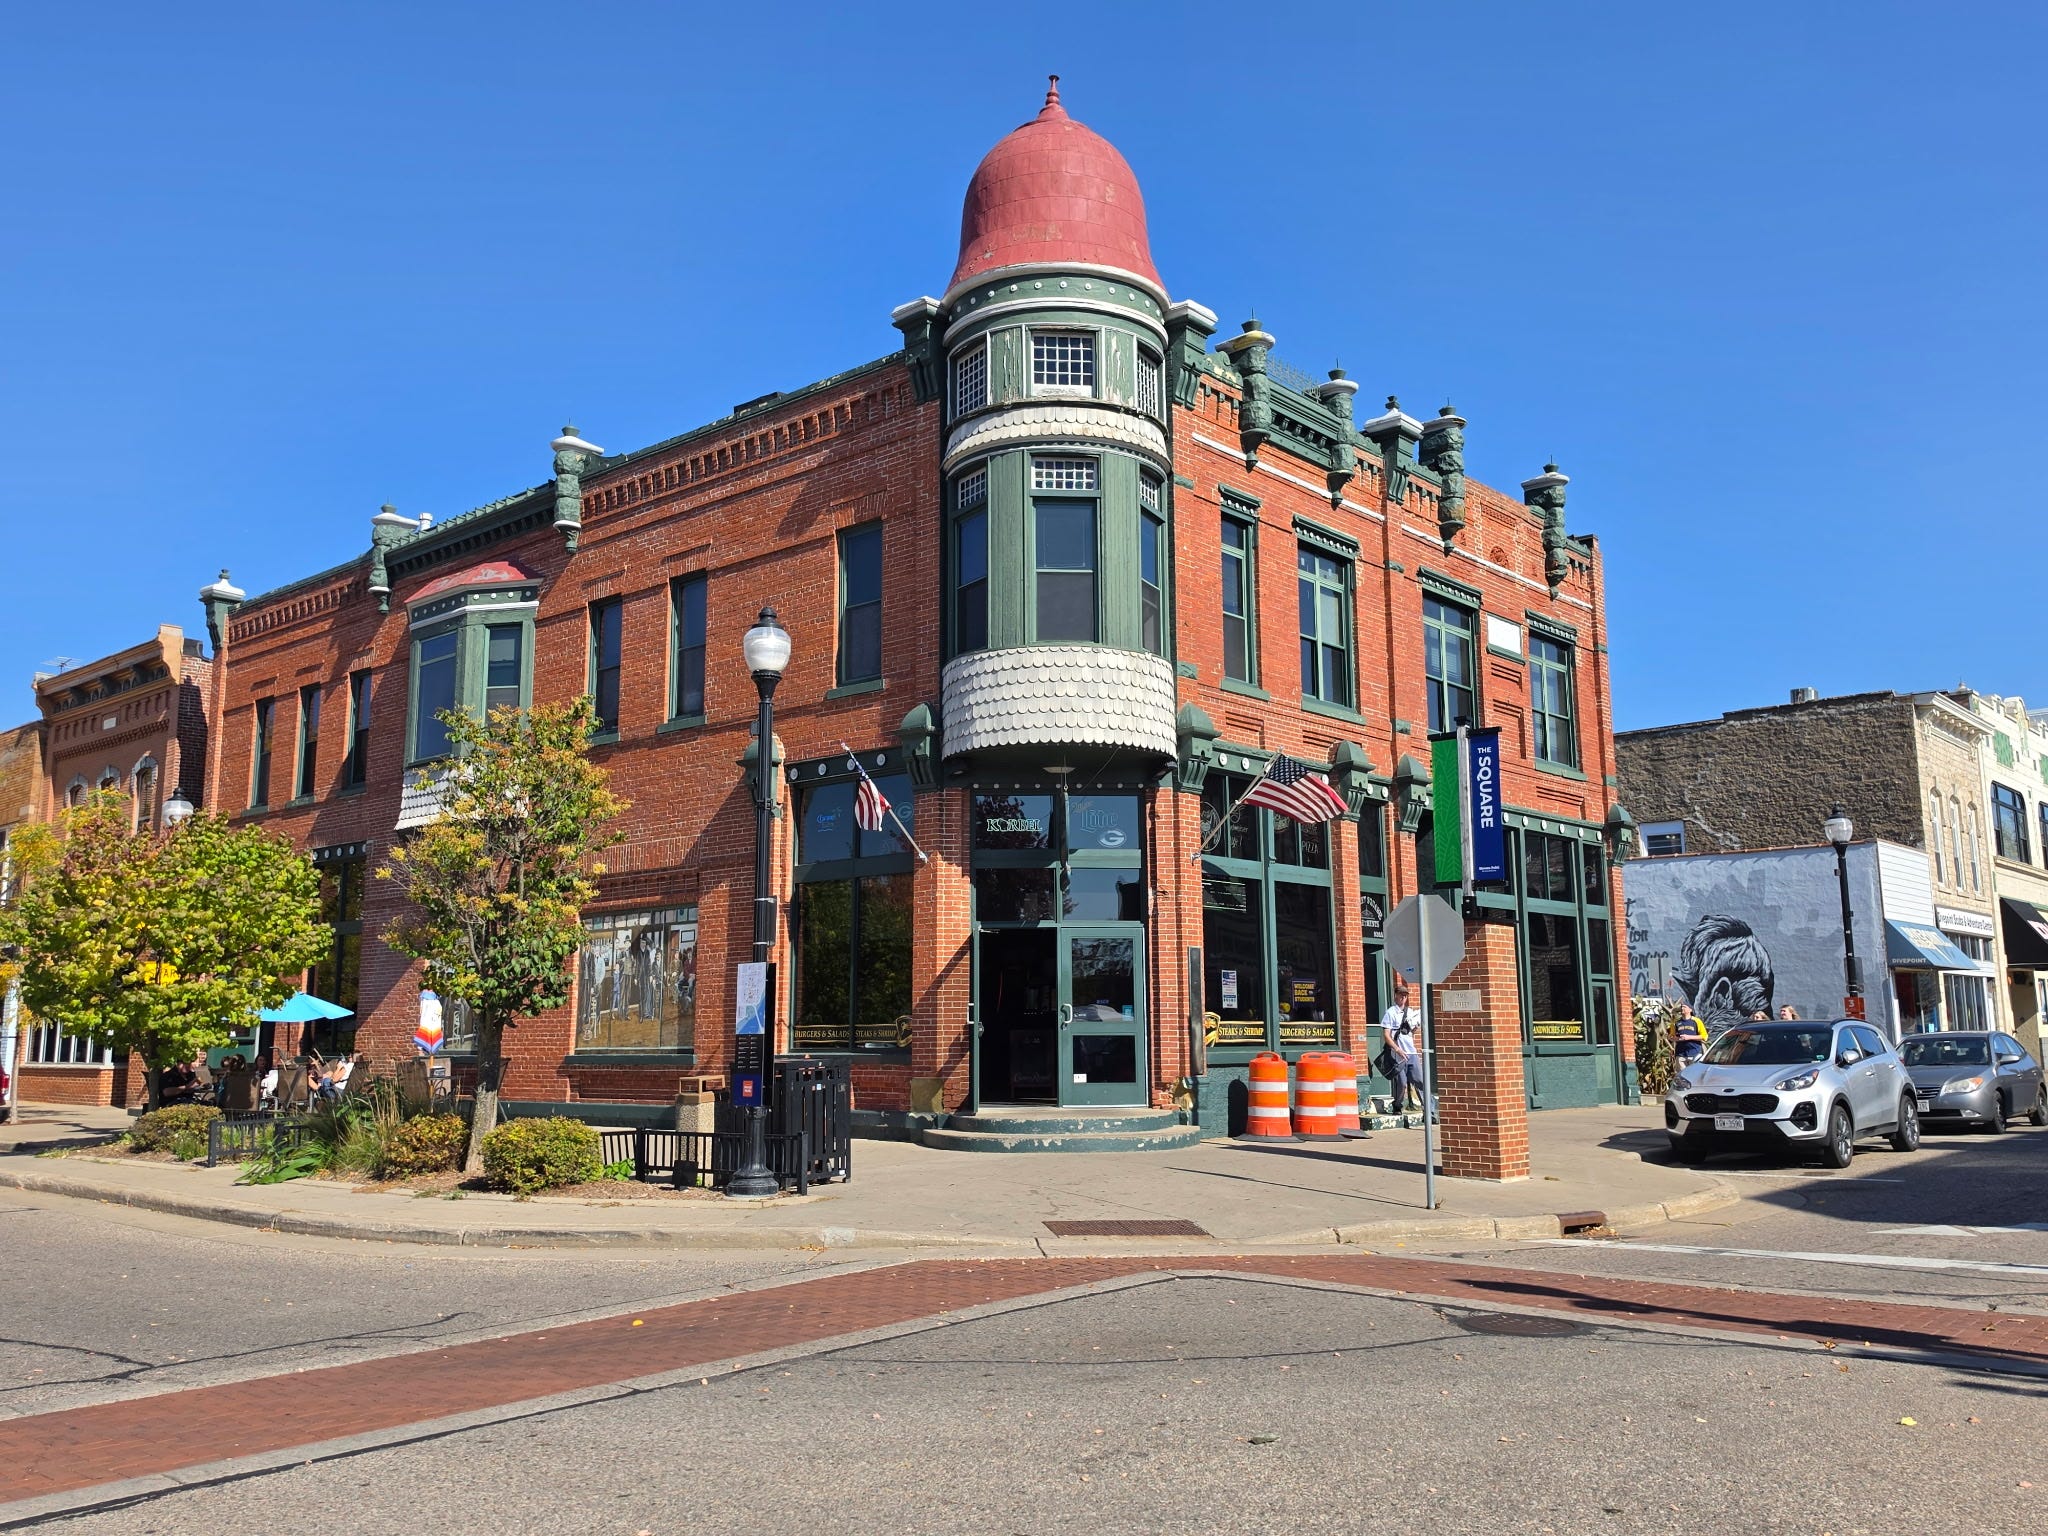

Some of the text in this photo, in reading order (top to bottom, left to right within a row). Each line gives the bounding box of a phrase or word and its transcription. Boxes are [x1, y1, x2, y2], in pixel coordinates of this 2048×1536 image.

[1477, 746, 1492, 754] THE
[1476, 756, 1494, 829] SQUARE
[1302, 840, 1319, 854] PIZZA
[794, 1029, 850, 1038] BURGERS & SALADS
[855, 1030, 874, 1038] STEAKS
[878, 1030, 897, 1038] SHRIMP
[1218, 1026, 1265, 1036] STEAKS & SHRIMP
[1306, 1028, 1312, 1036] &
[1312, 1027, 1335, 1036] SALADS
[1532, 1025, 1582, 1034] ANDWICHES & SOUPS
